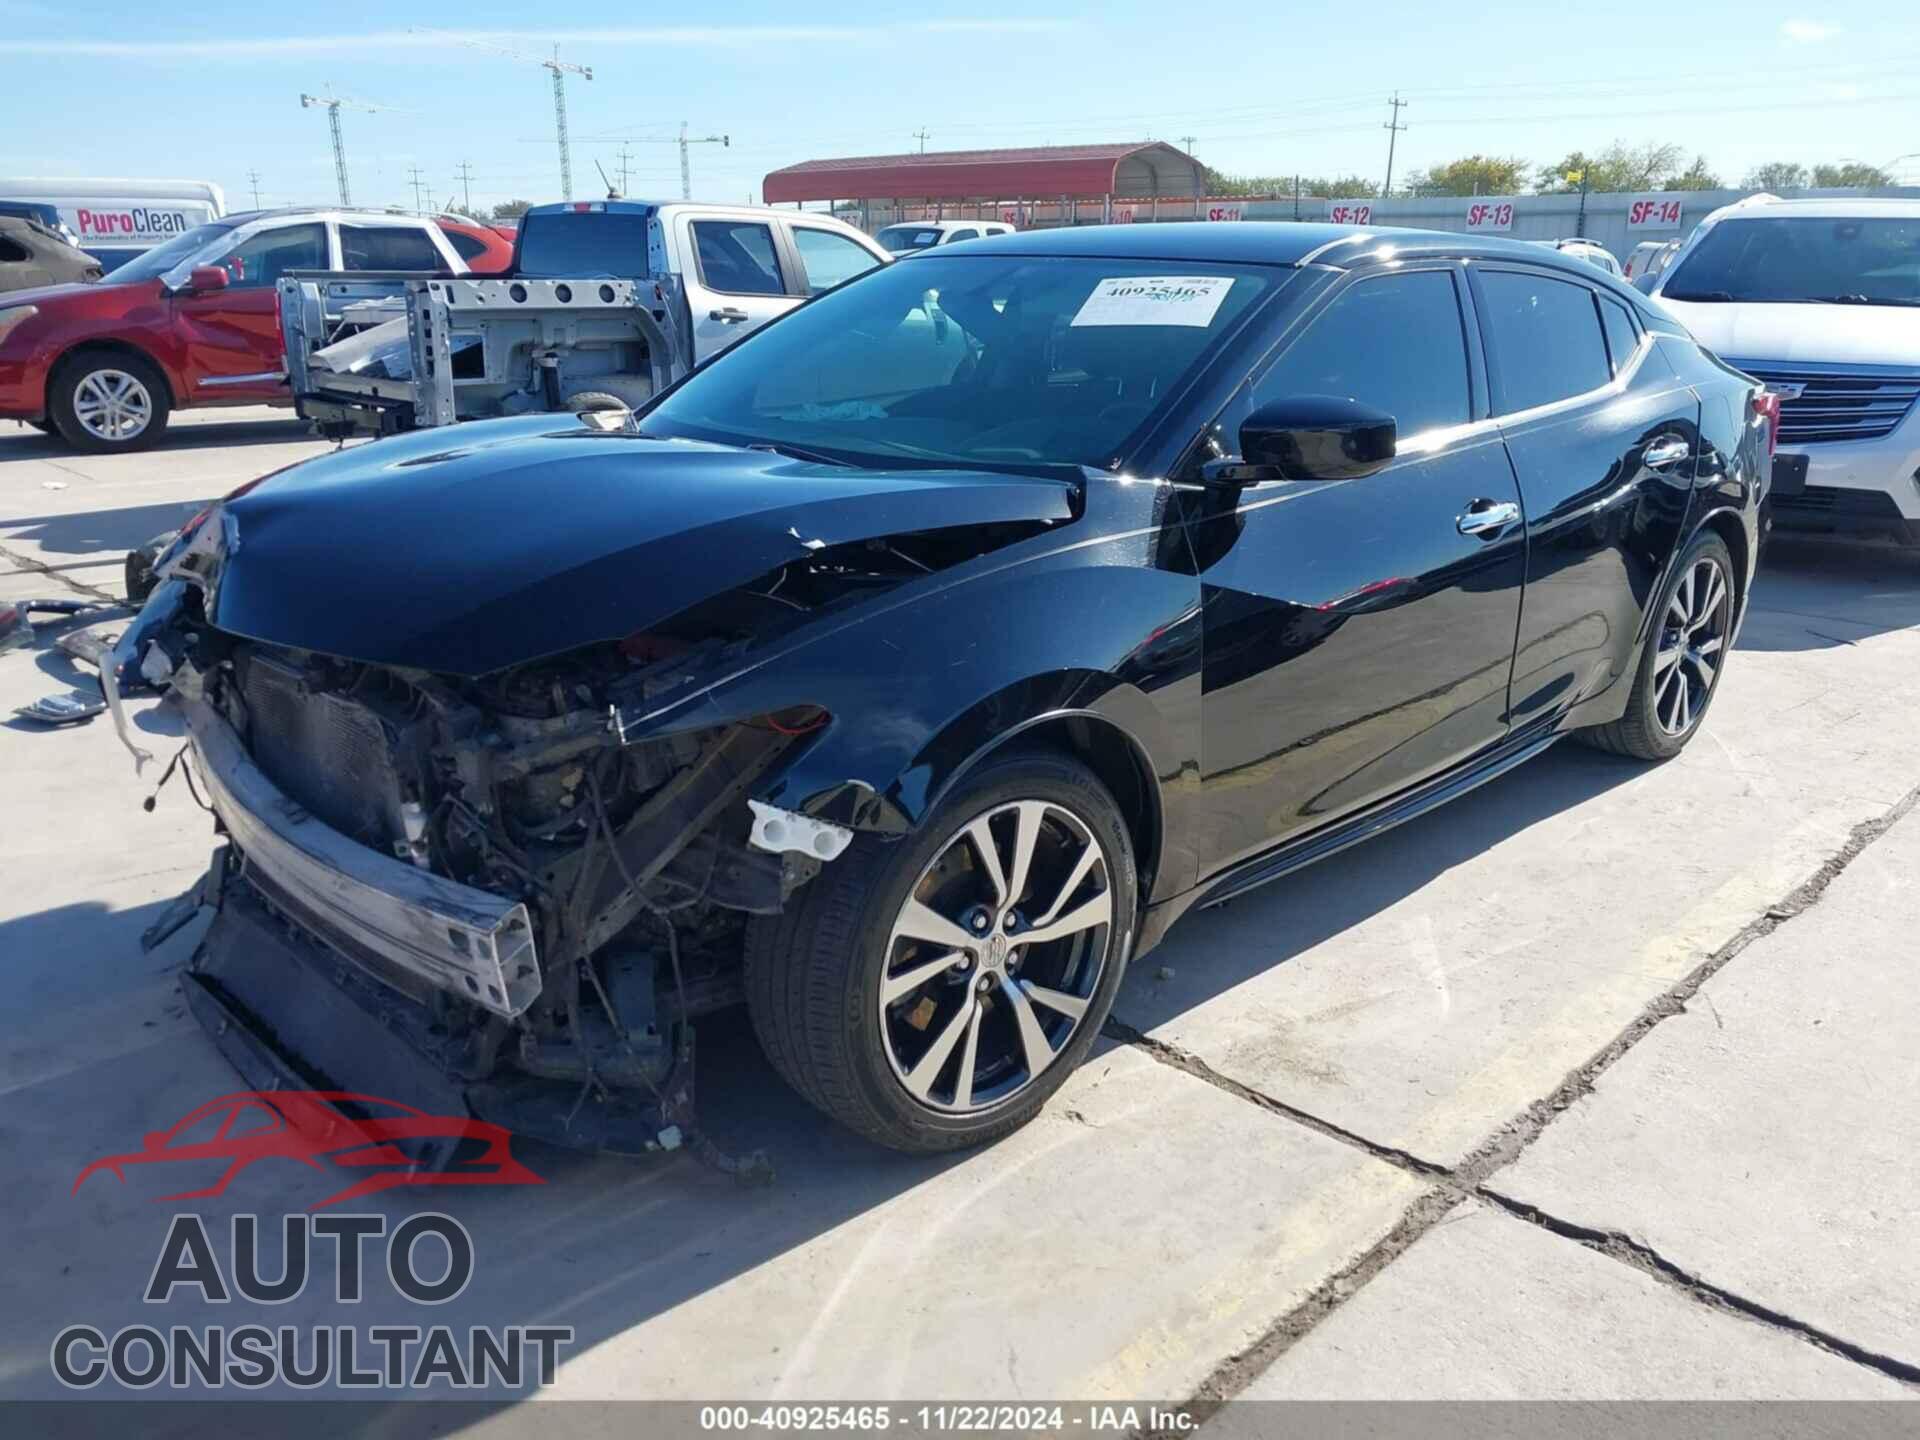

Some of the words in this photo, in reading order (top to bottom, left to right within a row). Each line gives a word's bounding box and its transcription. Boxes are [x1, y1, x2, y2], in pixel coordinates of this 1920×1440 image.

[77, 207, 186, 233] PuroClean
[1331, 206, 1369, 224] SF-12
[1468, 204, 1512, 226] SF-13
[1630, 201, 1680, 224] SF-14
